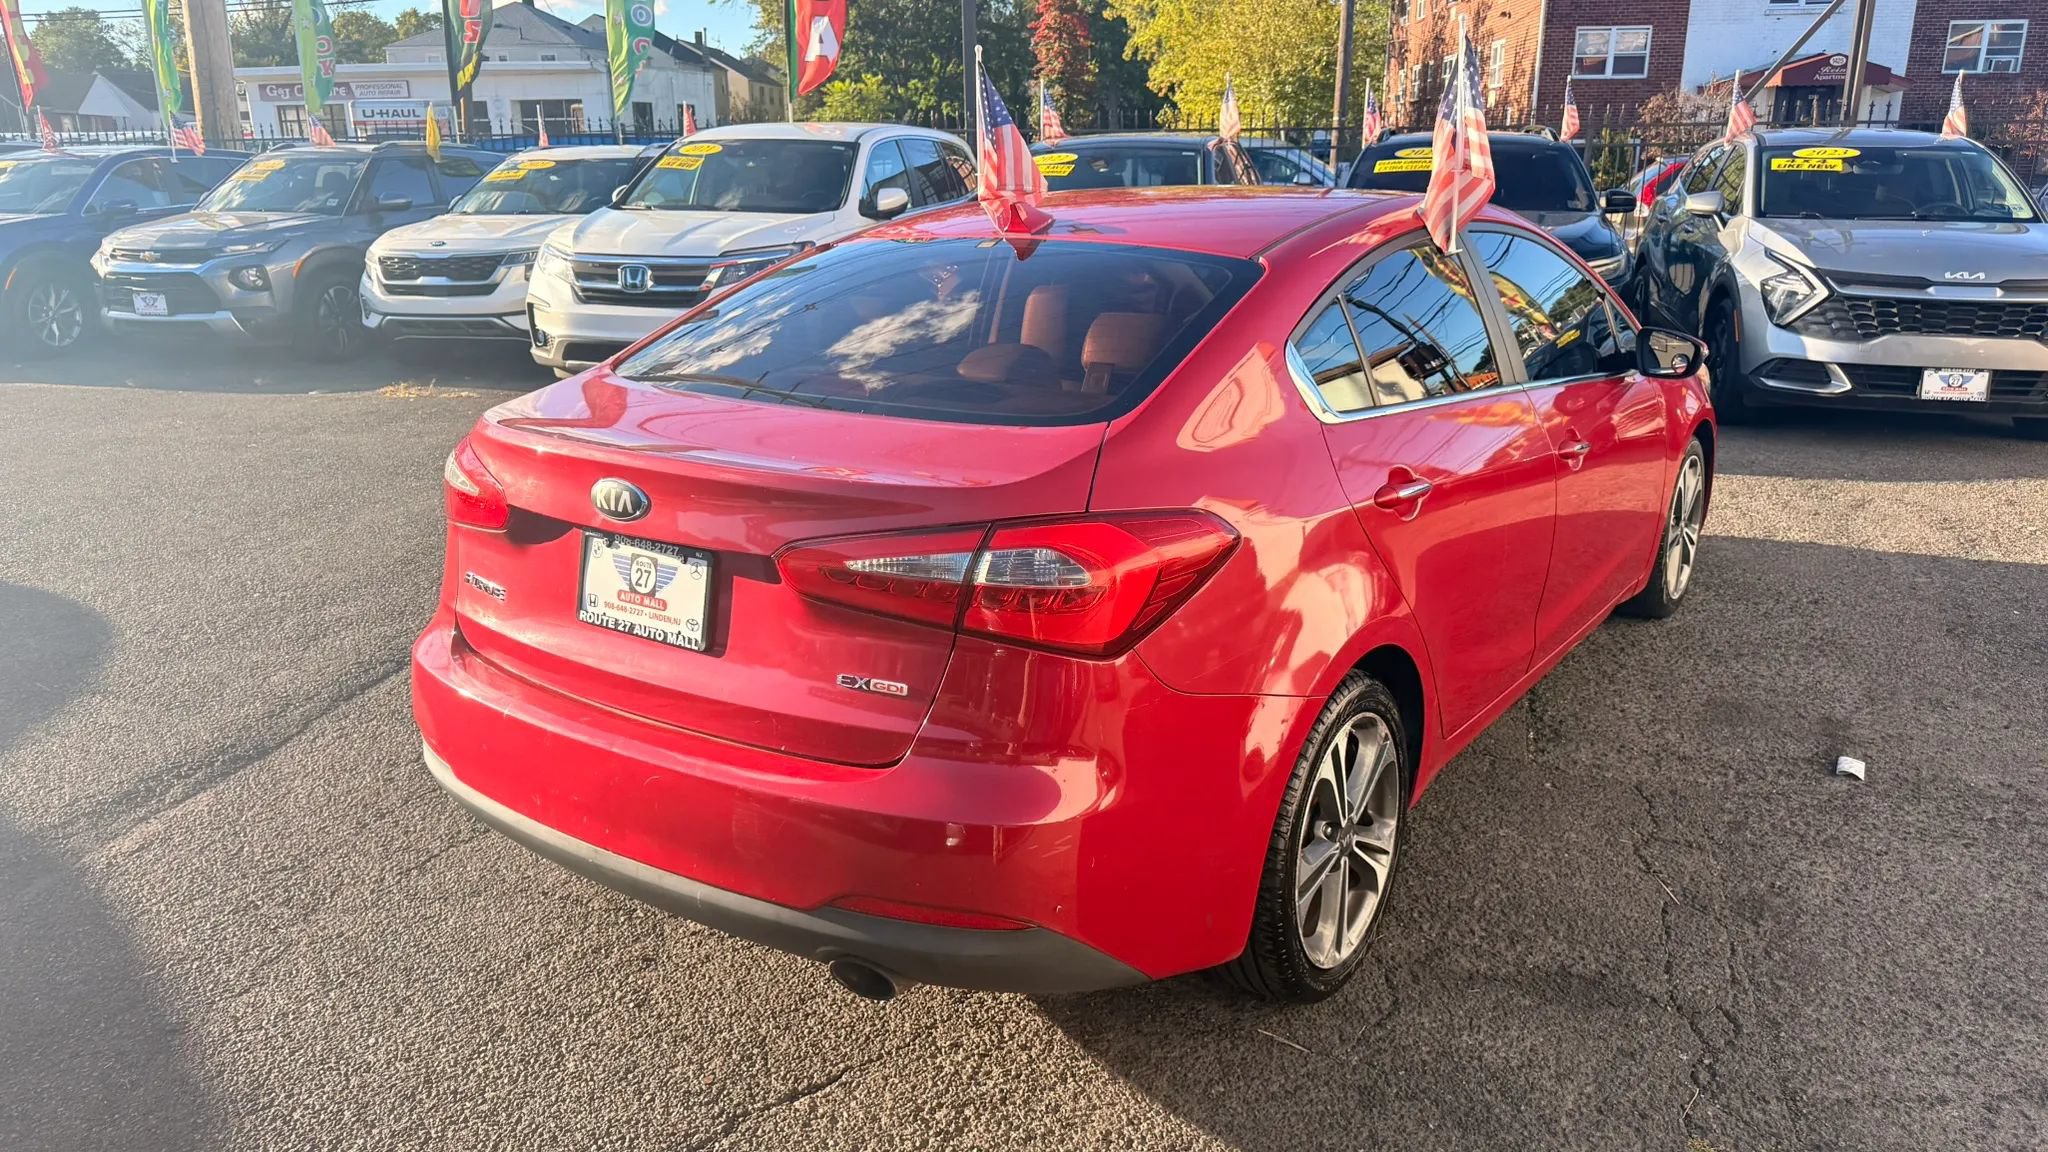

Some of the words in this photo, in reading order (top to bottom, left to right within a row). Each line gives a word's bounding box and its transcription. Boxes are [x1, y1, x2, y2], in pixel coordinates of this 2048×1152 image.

[355, 83, 404, 91] PROFESSIONAL
[362, 108, 421, 118] U-HAUL
[1806, 148, 1849, 157] 2023
[596, 487, 634, 514] KIA
[614, 534, 680, 556] 908-648-2727
[634, 567, 652, 589] 27
[604, 601, 644, 616] 908-648-2727
[619, 591, 641, 606] AUTO
[643, 596, 665, 610] MALL
[579, 610, 618, 629] ROUTE
[618, 620, 632, 633] 27
[633, 624, 665, 641] AUTO
[667, 631, 699, 651] MALL
